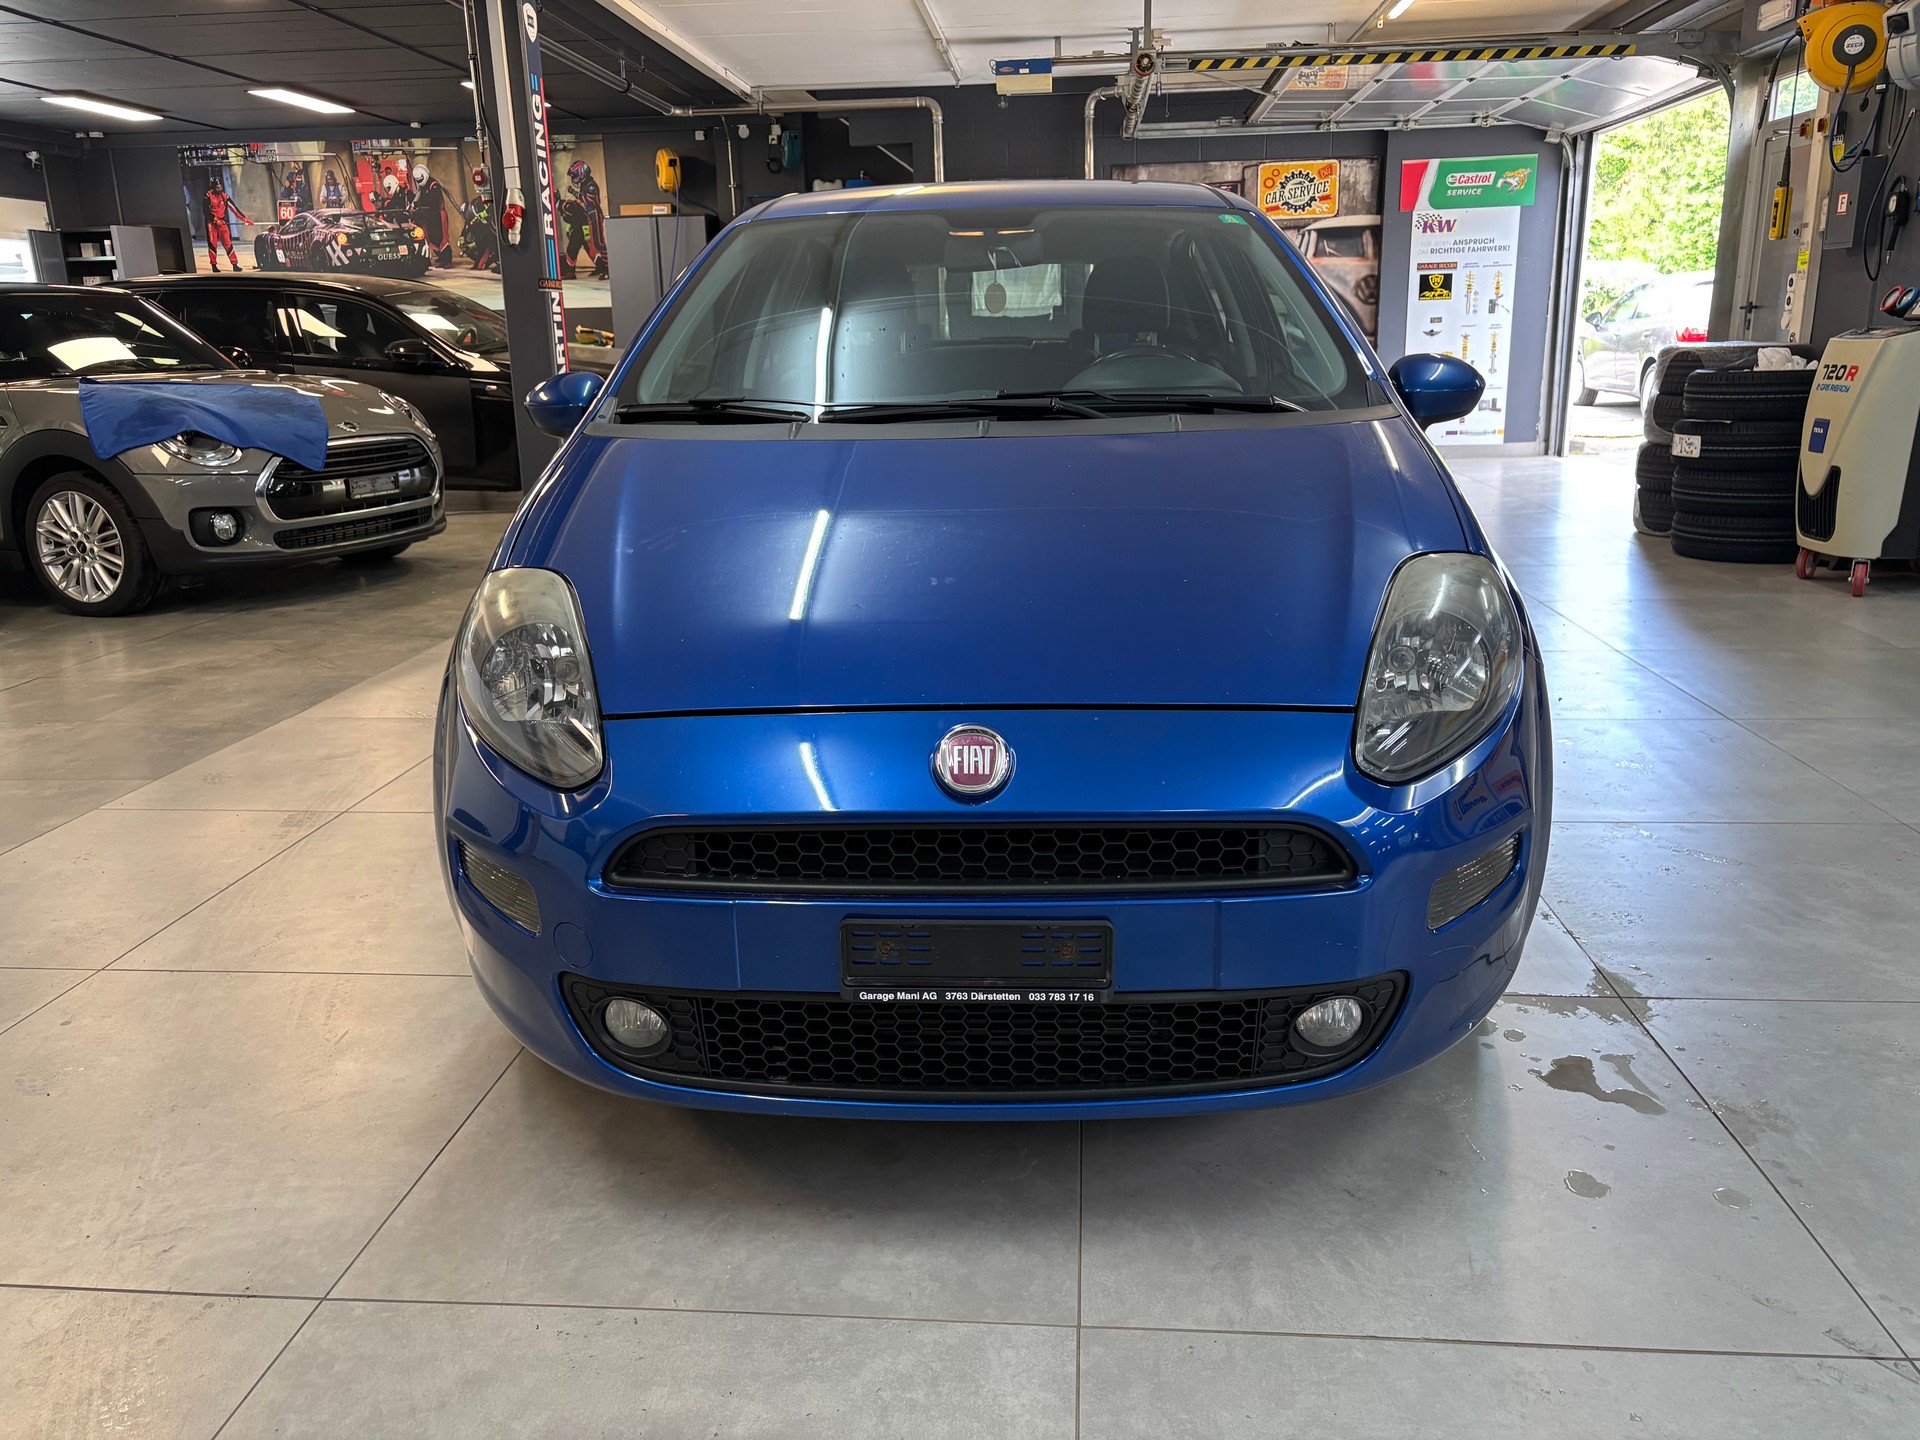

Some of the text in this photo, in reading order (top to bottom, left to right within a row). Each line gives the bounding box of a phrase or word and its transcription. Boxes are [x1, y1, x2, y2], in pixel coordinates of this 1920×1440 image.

[532, 94, 554, 236] RACING
[1457, 172, 1492, 185] Castrol
[1265, 181, 1329, 205] CAR SERVICE
[1446, 188, 1483, 197] SERVICE
[1839, 197, 1846, 210] F
[280, 206, 294, 220] 60
[1421, 219, 1457, 234] KW
[1452, 237, 1495, 246] ANSPRUCH
[1430, 246, 1466, 255] RICHTIGE
[1467, 244, 1511, 254] FAHRWERK!
[1823, 364, 1859, 382] 720R
[953, 745, 994, 775] FIAT
[859, 991, 895, 1002] Garage
[922, 992, 938, 1000] AG
[945, 992, 968, 1001] 3763
[970, 991, 1021, 1001] Därstetten
[1028, 993, 1047, 1002] 033
[1049, 993, 1066, 1002] 783
[1068, 993, 1080, 1002] 17
[1082, 993, 1095, 1002] 16
